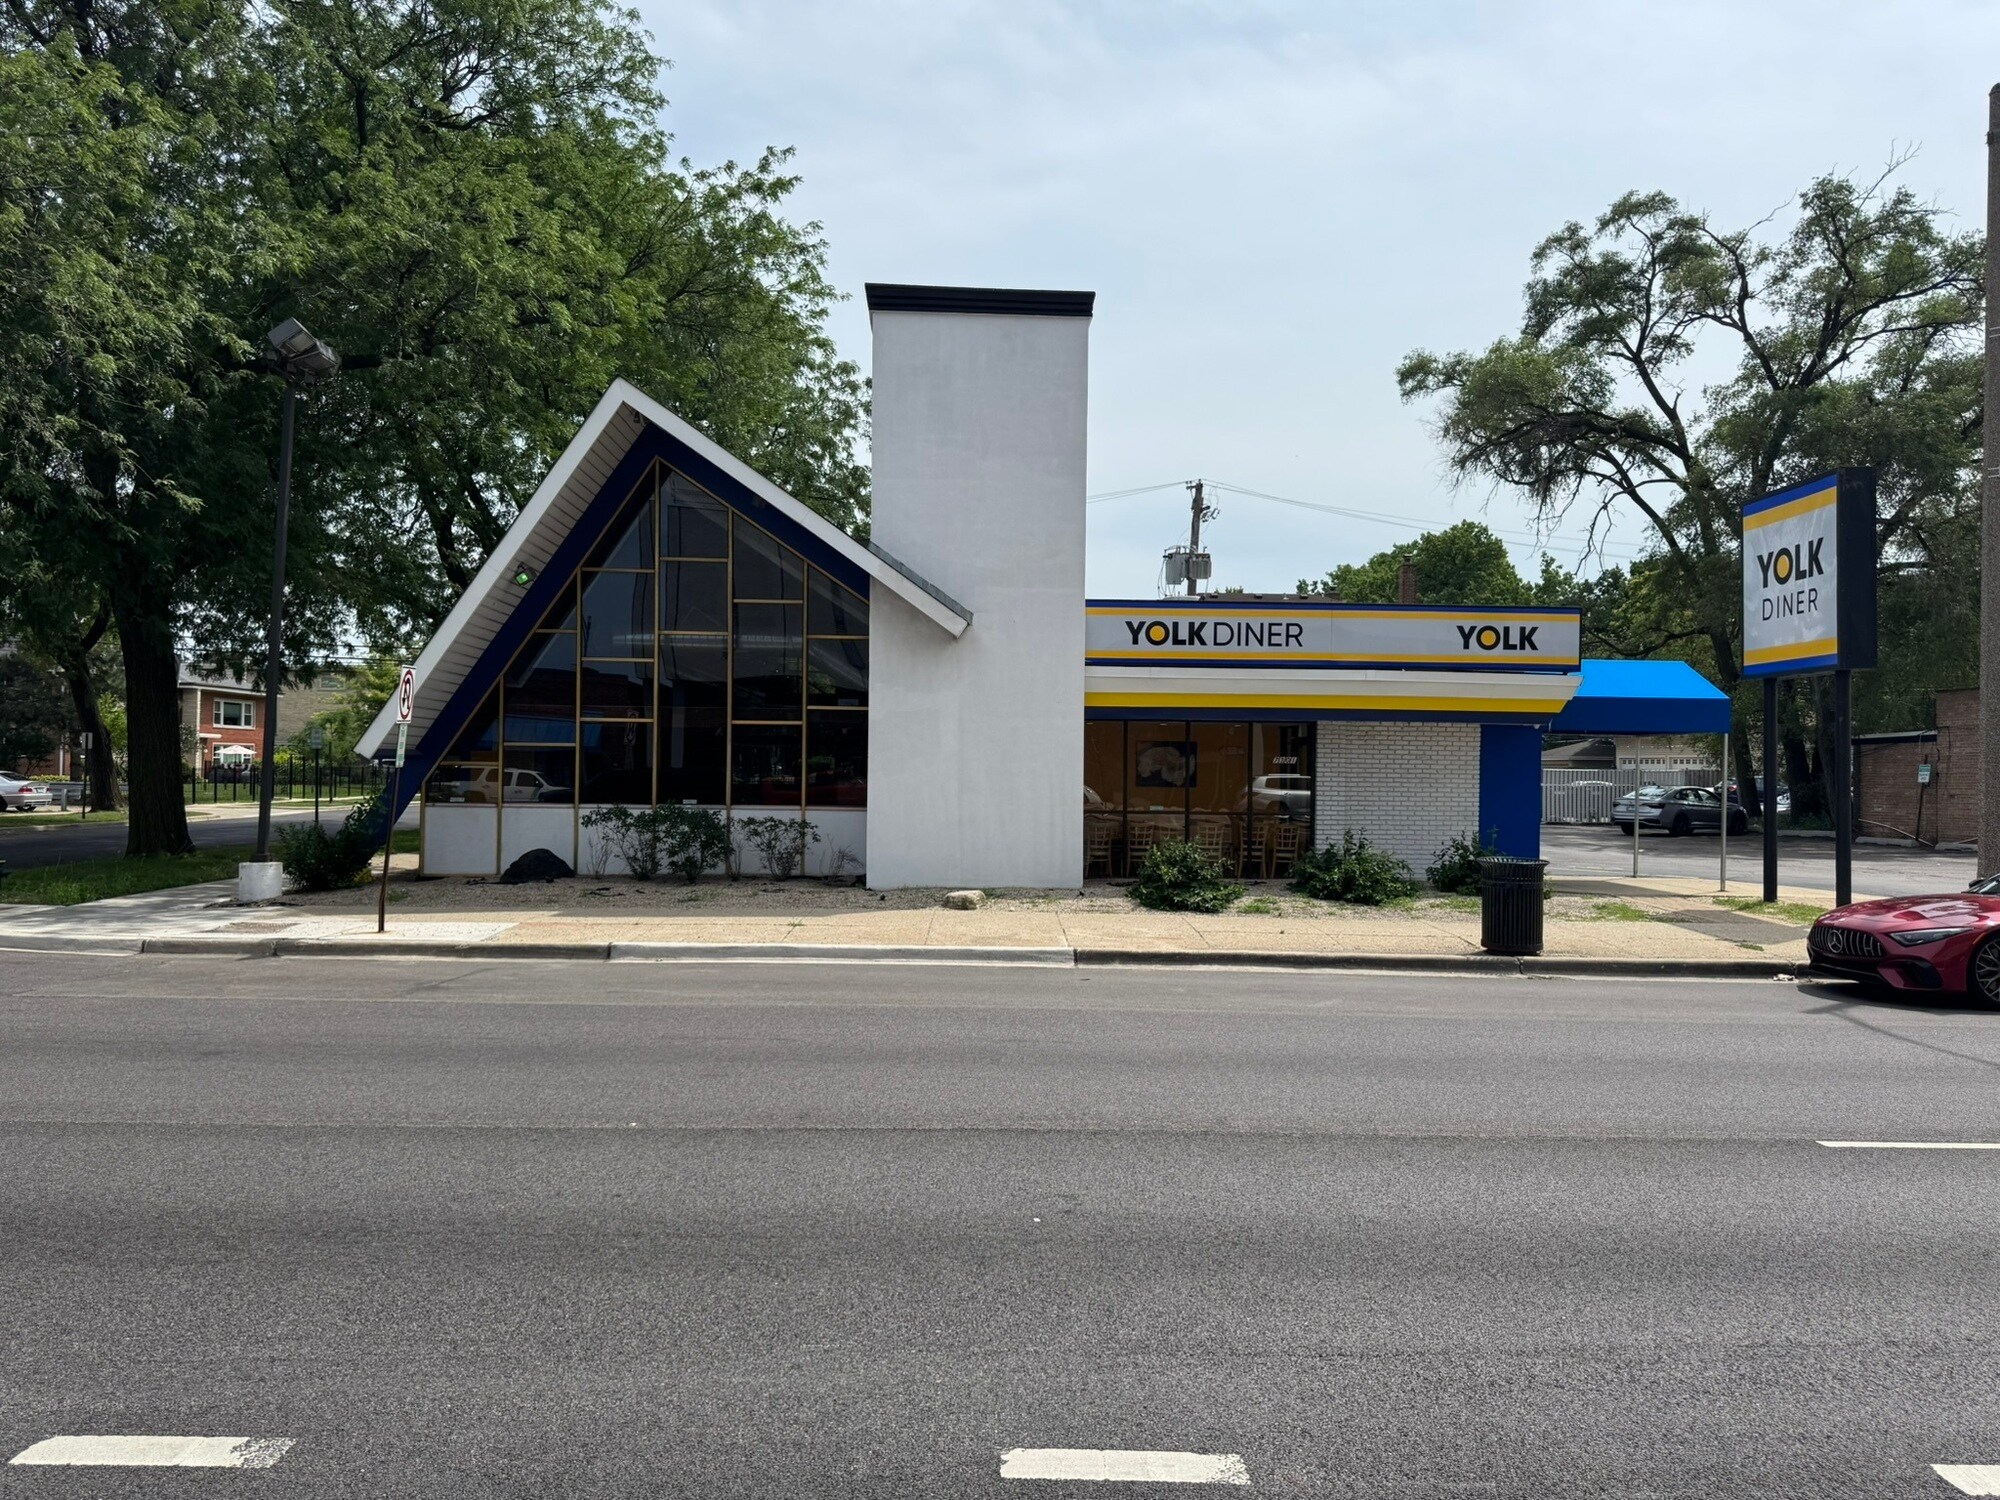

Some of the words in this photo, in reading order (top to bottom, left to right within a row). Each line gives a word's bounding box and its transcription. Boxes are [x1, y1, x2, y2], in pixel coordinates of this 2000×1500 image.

[1757, 536, 1824, 588] YOLK
[1762, 587, 1818, 621] DINER
[1125, 620, 1208, 646] YOLK
[1213, 621, 1303, 647] DINER
[1456, 625, 1539, 651] YOLK
